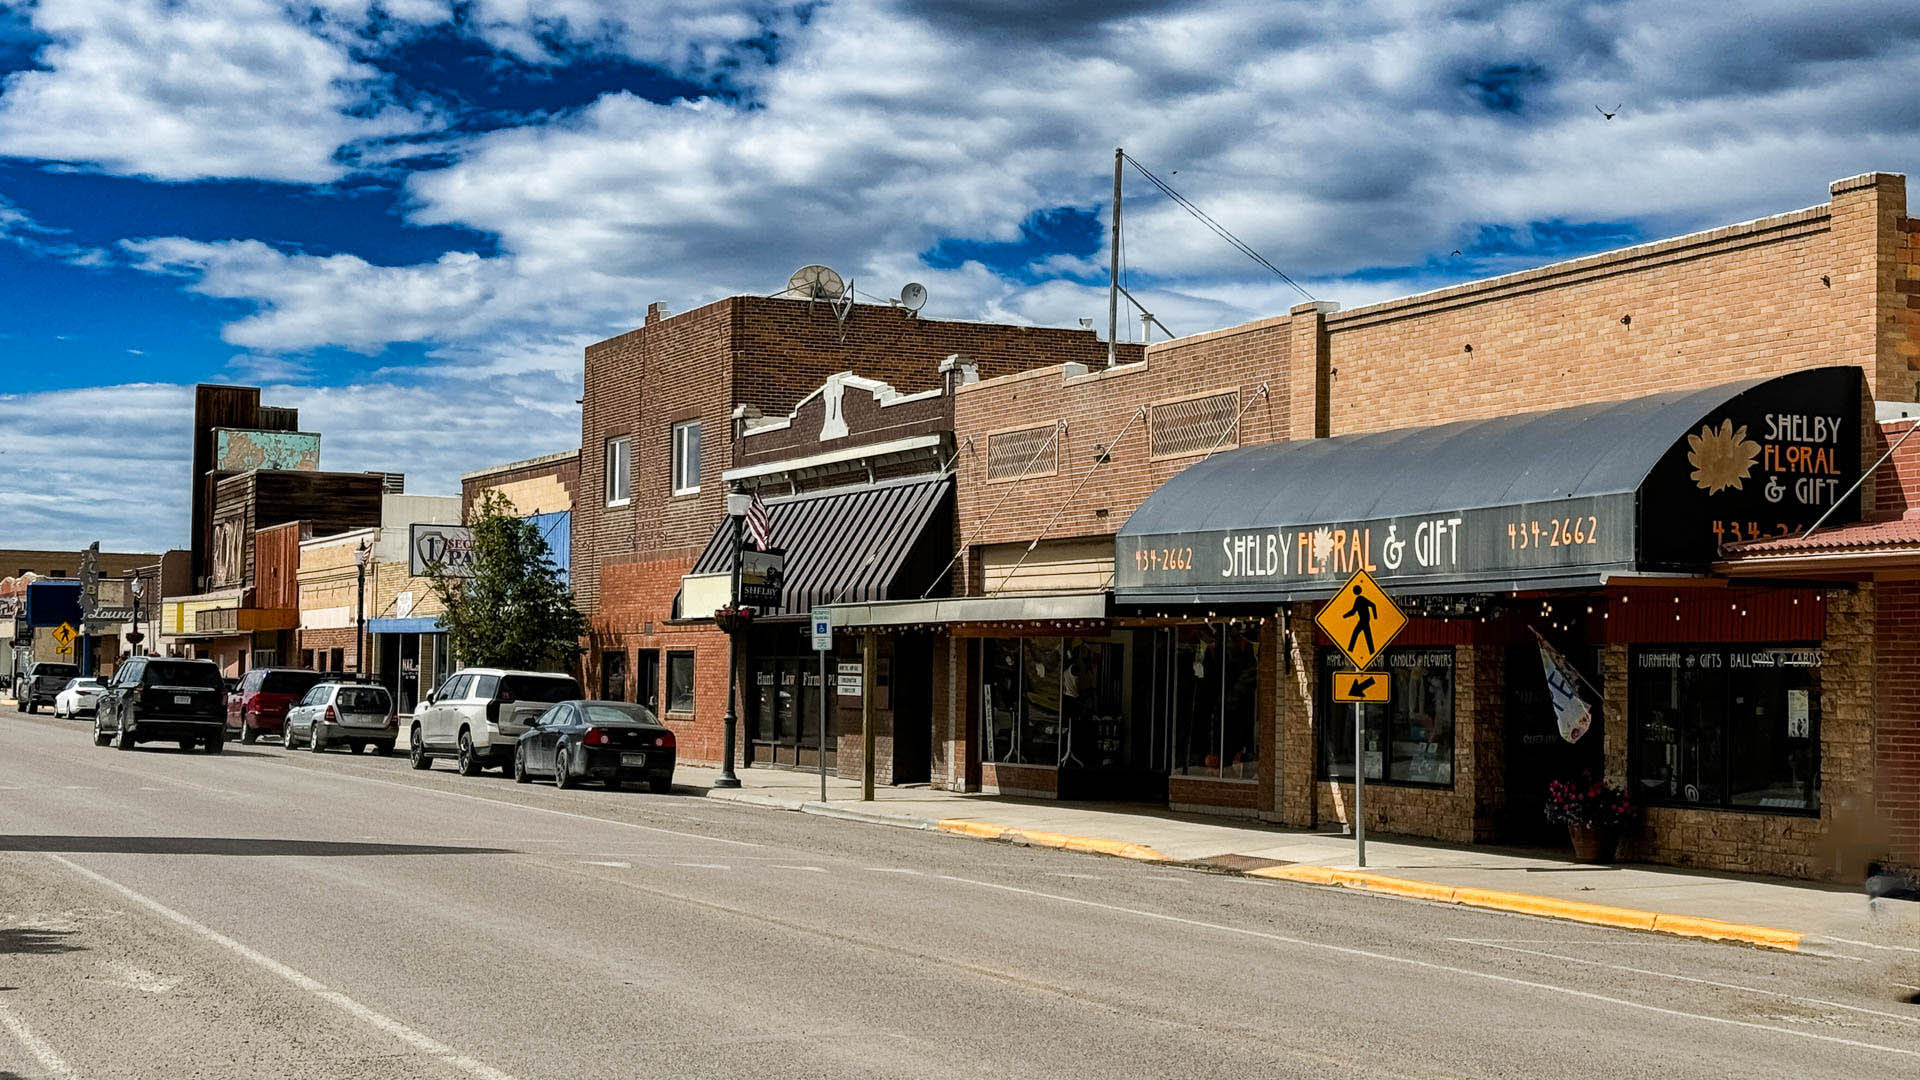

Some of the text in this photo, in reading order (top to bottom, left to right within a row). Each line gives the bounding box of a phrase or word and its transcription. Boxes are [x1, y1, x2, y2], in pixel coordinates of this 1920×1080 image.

[1764, 413, 1842, 444] SHELBY
[1764, 444, 1841, 475] FLORAL
[1764, 476, 1840, 506] & GIFT
[1507, 515, 1598, 550] 434-2662
[1135, 547, 1193, 572] 434-2662
[1222, 532, 1293, 578] SHELBY
[1382, 525, 1406, 570] &
[1414, 518, 1462, 567] GIFT
[744, 586, 778, 597] SHELBY
[87, 607, 144, 623] Lounge
[1390, 654, 1453, 667] CANDLES FLOWERS
[1639, 652, 1822, 668] FURNITURE GIFTS BALLOONS CARDS
[757, 671, 774, 686] Hunt
[781, 671, 796, 686] Law
